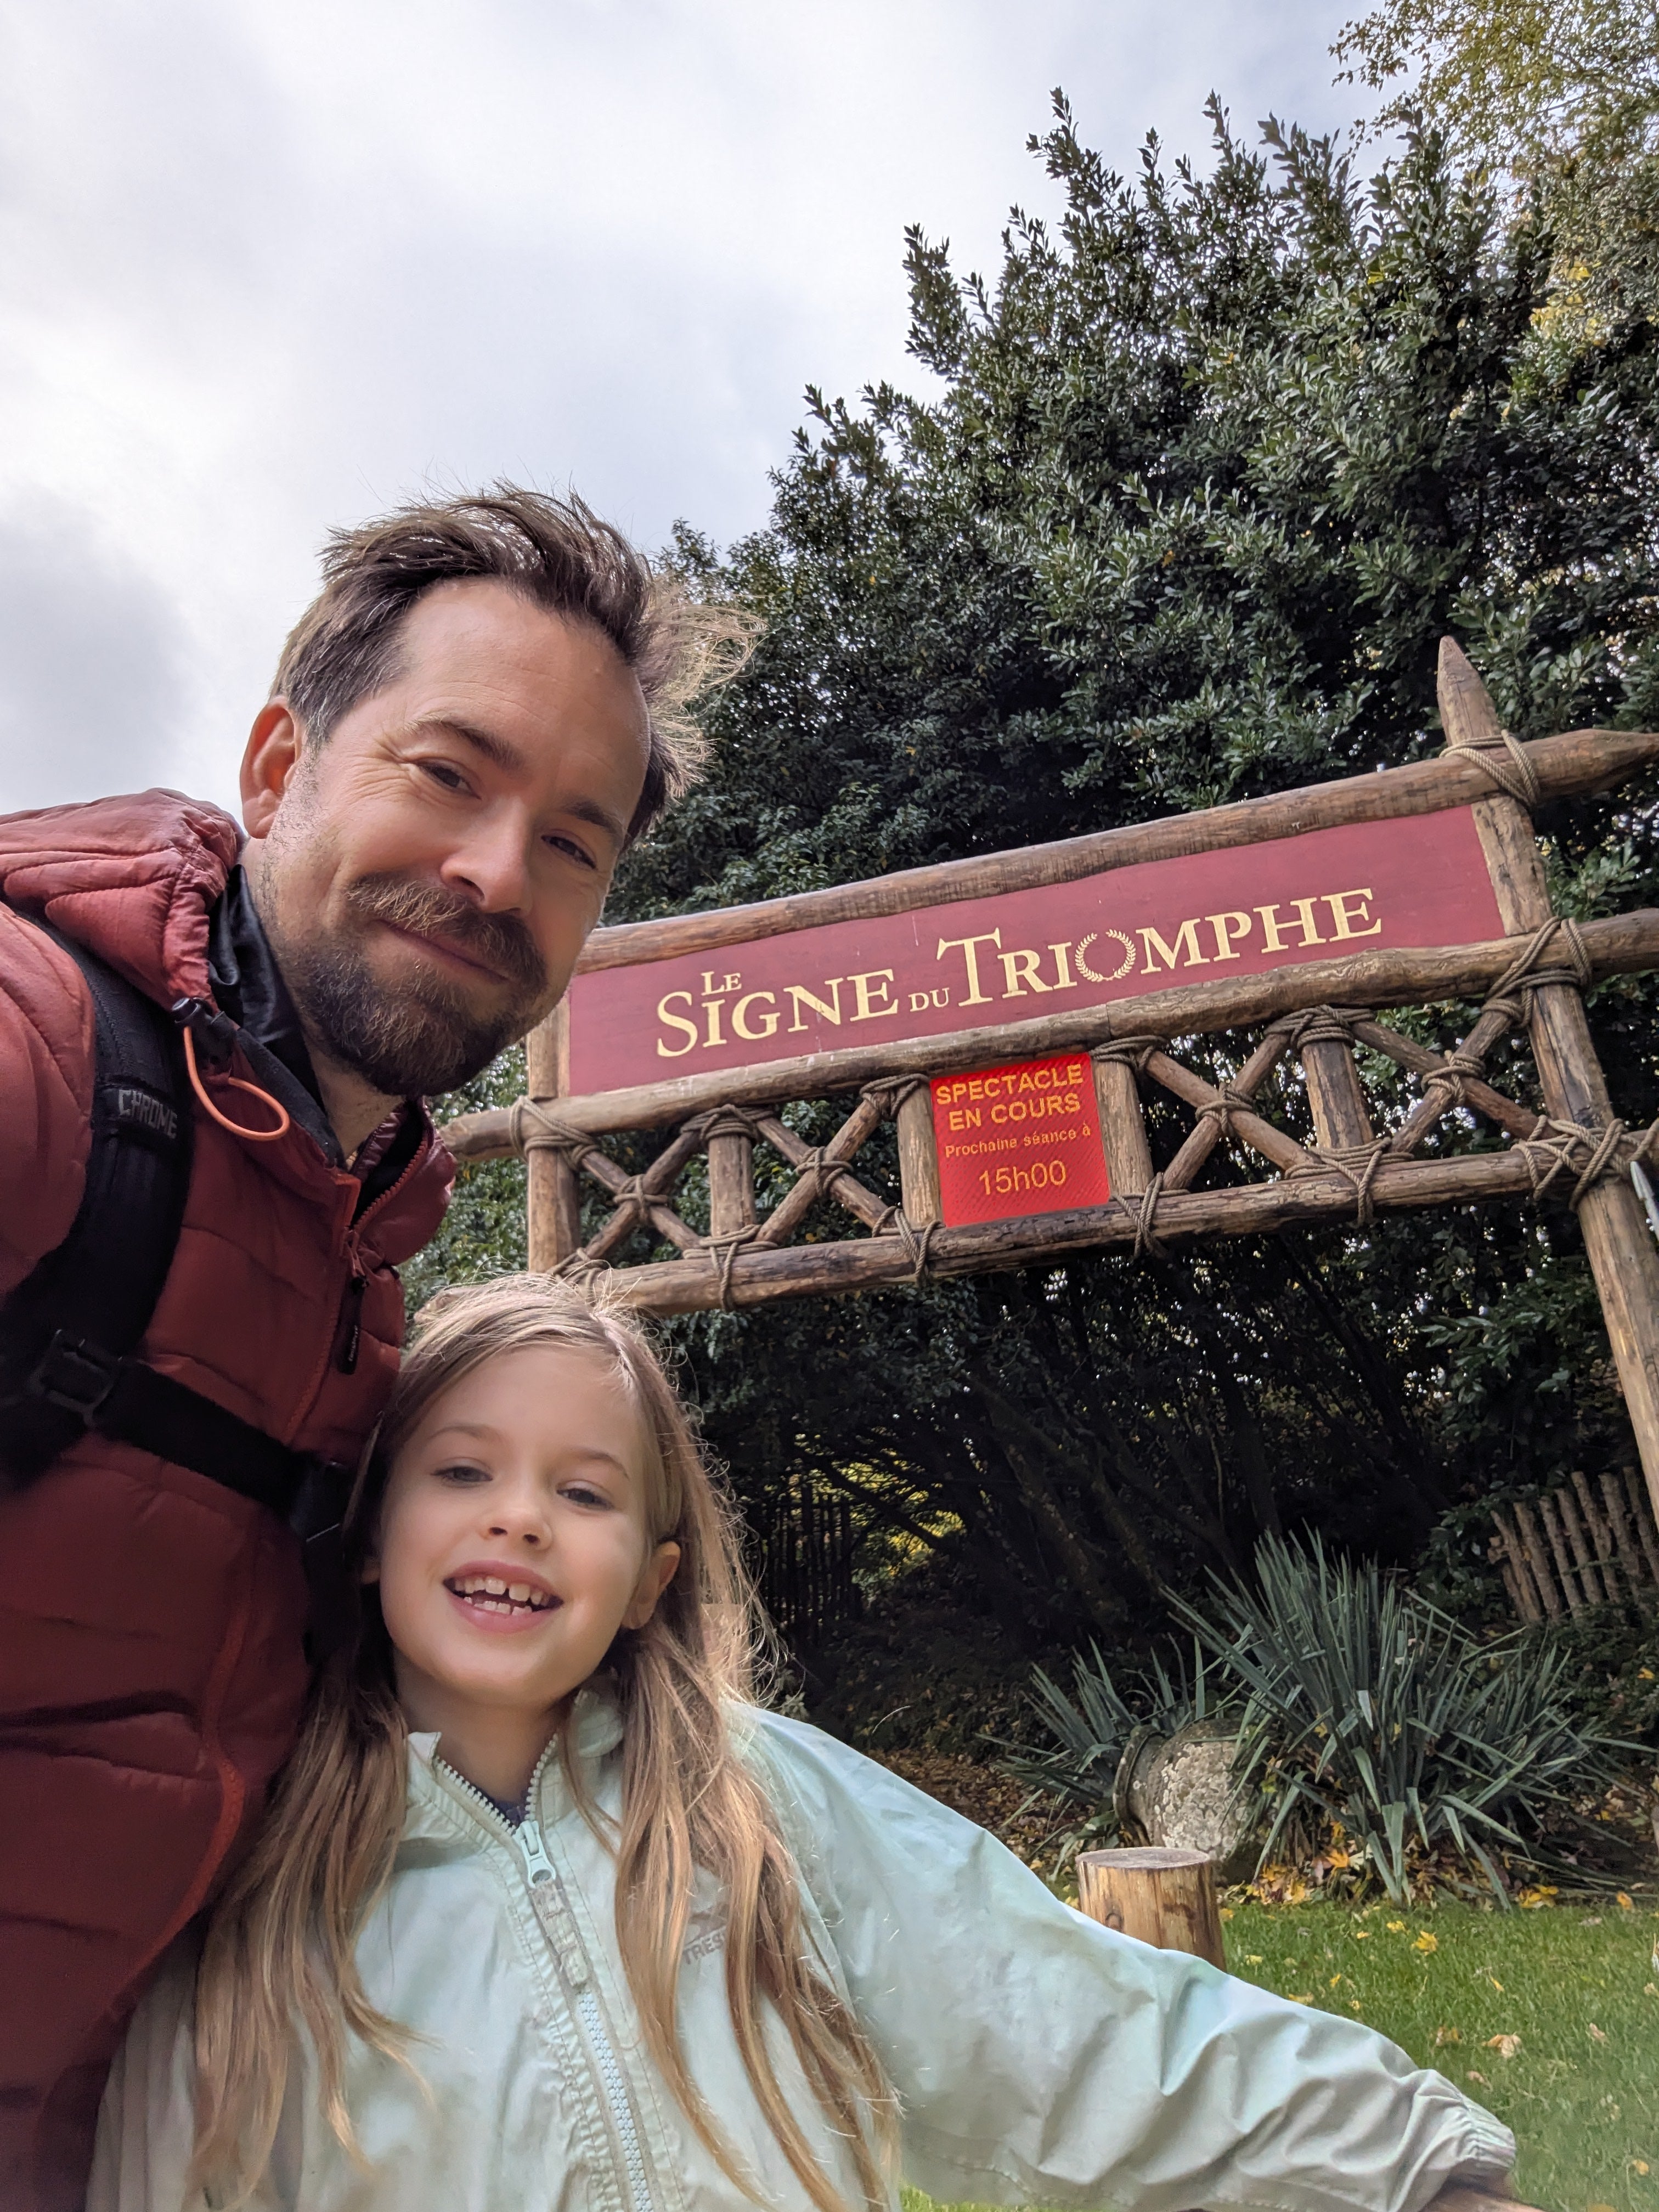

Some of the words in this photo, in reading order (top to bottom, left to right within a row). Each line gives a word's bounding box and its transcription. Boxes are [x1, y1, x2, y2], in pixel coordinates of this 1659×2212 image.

[656, 969, 899, 1057] SIGNE
[909, 987, 950, 1012] DU
[936, 1064, 1083, 1105] SPECTACLE
[118, 1089, 178, 1139] CHROME
[949, 1108, 981, 1131] EN
[991, 1092, 1081, 1124] COURS
[945, 1137, 1017, 1158] Prochaine
[1023, 1131, 1076, 1147] séance
[1082, 1122, 1091, 1136] à
[979, 1160, 1066, 1195] 15h00
